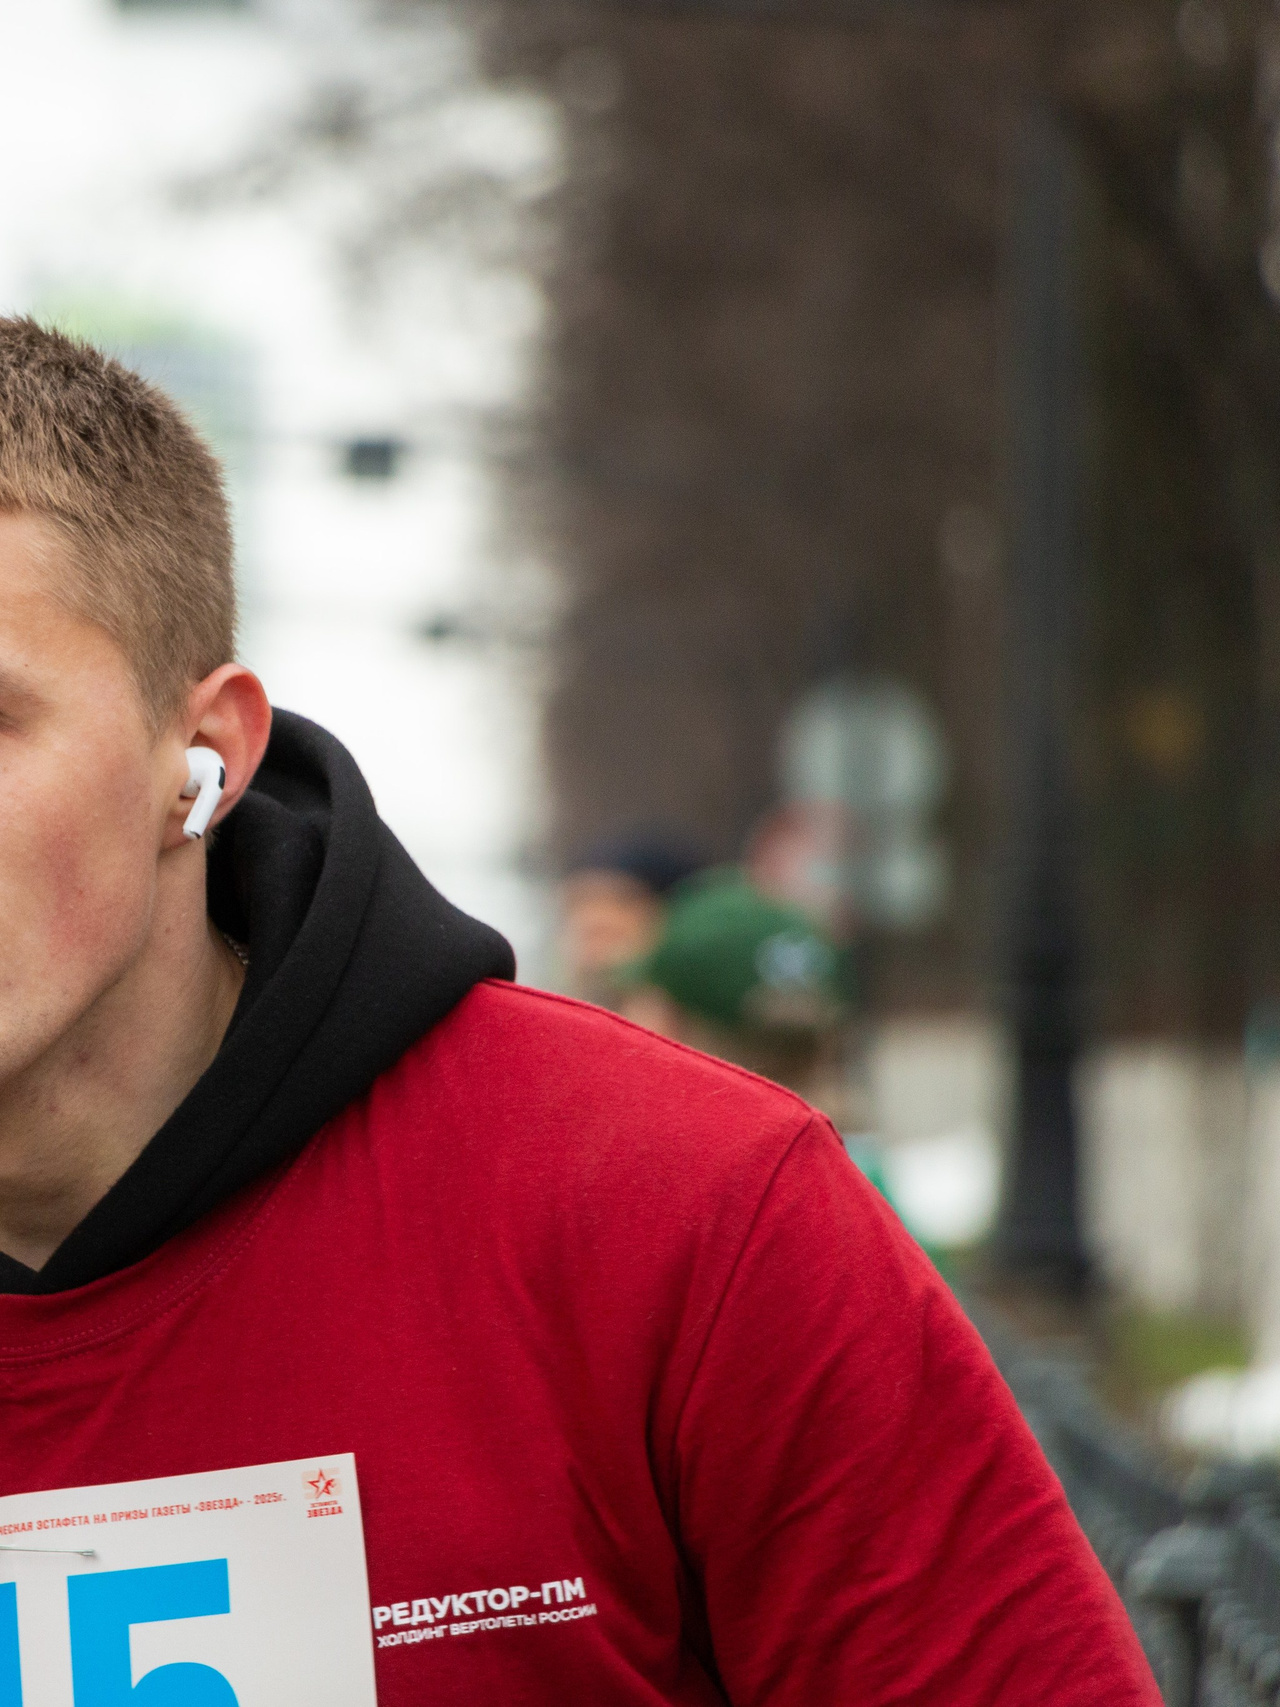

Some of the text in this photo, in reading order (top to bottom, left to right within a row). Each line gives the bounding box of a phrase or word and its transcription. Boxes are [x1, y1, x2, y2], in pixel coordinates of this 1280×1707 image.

[36, 1515, 90, 1531] ЭСТАФЕТА
[93, 1512, 108, 1524] НА
[110, 1508, 149, 1522] ПРИЗЫ
[151, 1503, 191, 1518] ГАЗЕТЫ
[372, 1576, 586, 1630] РЕДУКТОР-ПМ
[376, 1602, 598, 1648] ХОЛДИНГ ВЕРТОЛЕТЫ РОССИИ
